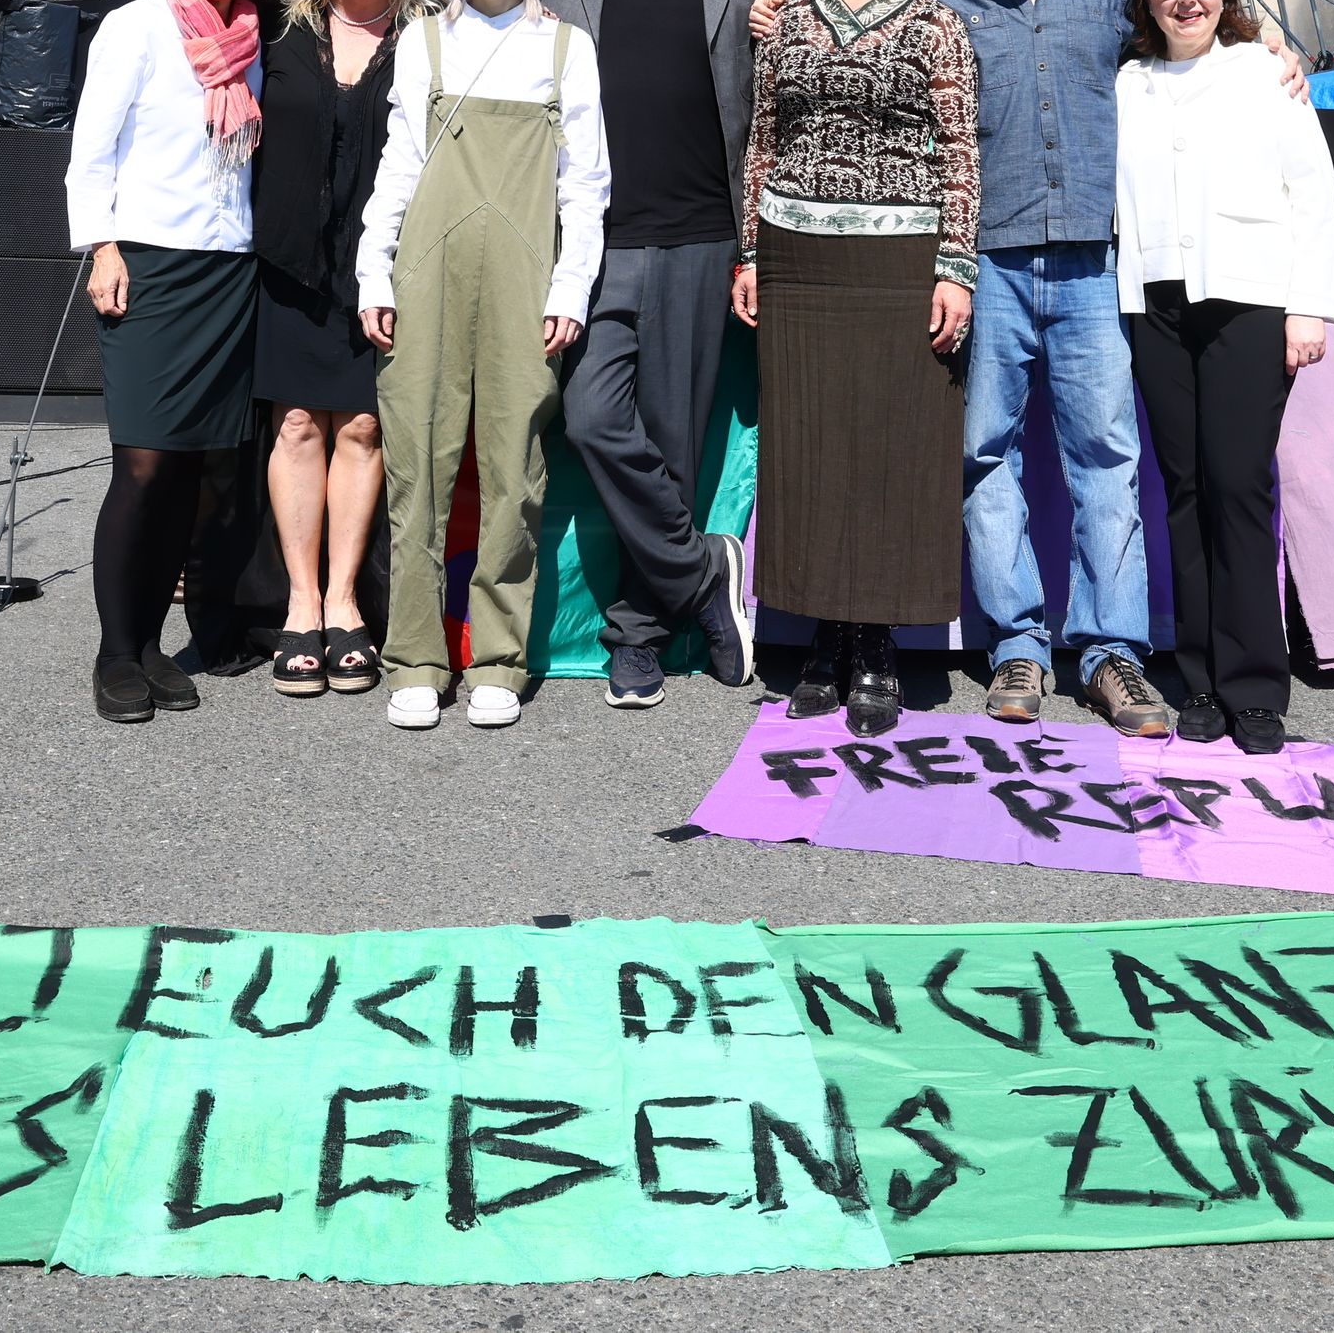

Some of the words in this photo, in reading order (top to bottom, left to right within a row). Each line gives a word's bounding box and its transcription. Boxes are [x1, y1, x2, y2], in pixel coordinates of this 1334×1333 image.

[760, 734, 1087, 800] FREIE
[117, 924, 542, 1058] EUCH
[618, 956, 904, 1036] DEN
[163, 1074, 985, 1230] LEBENS
